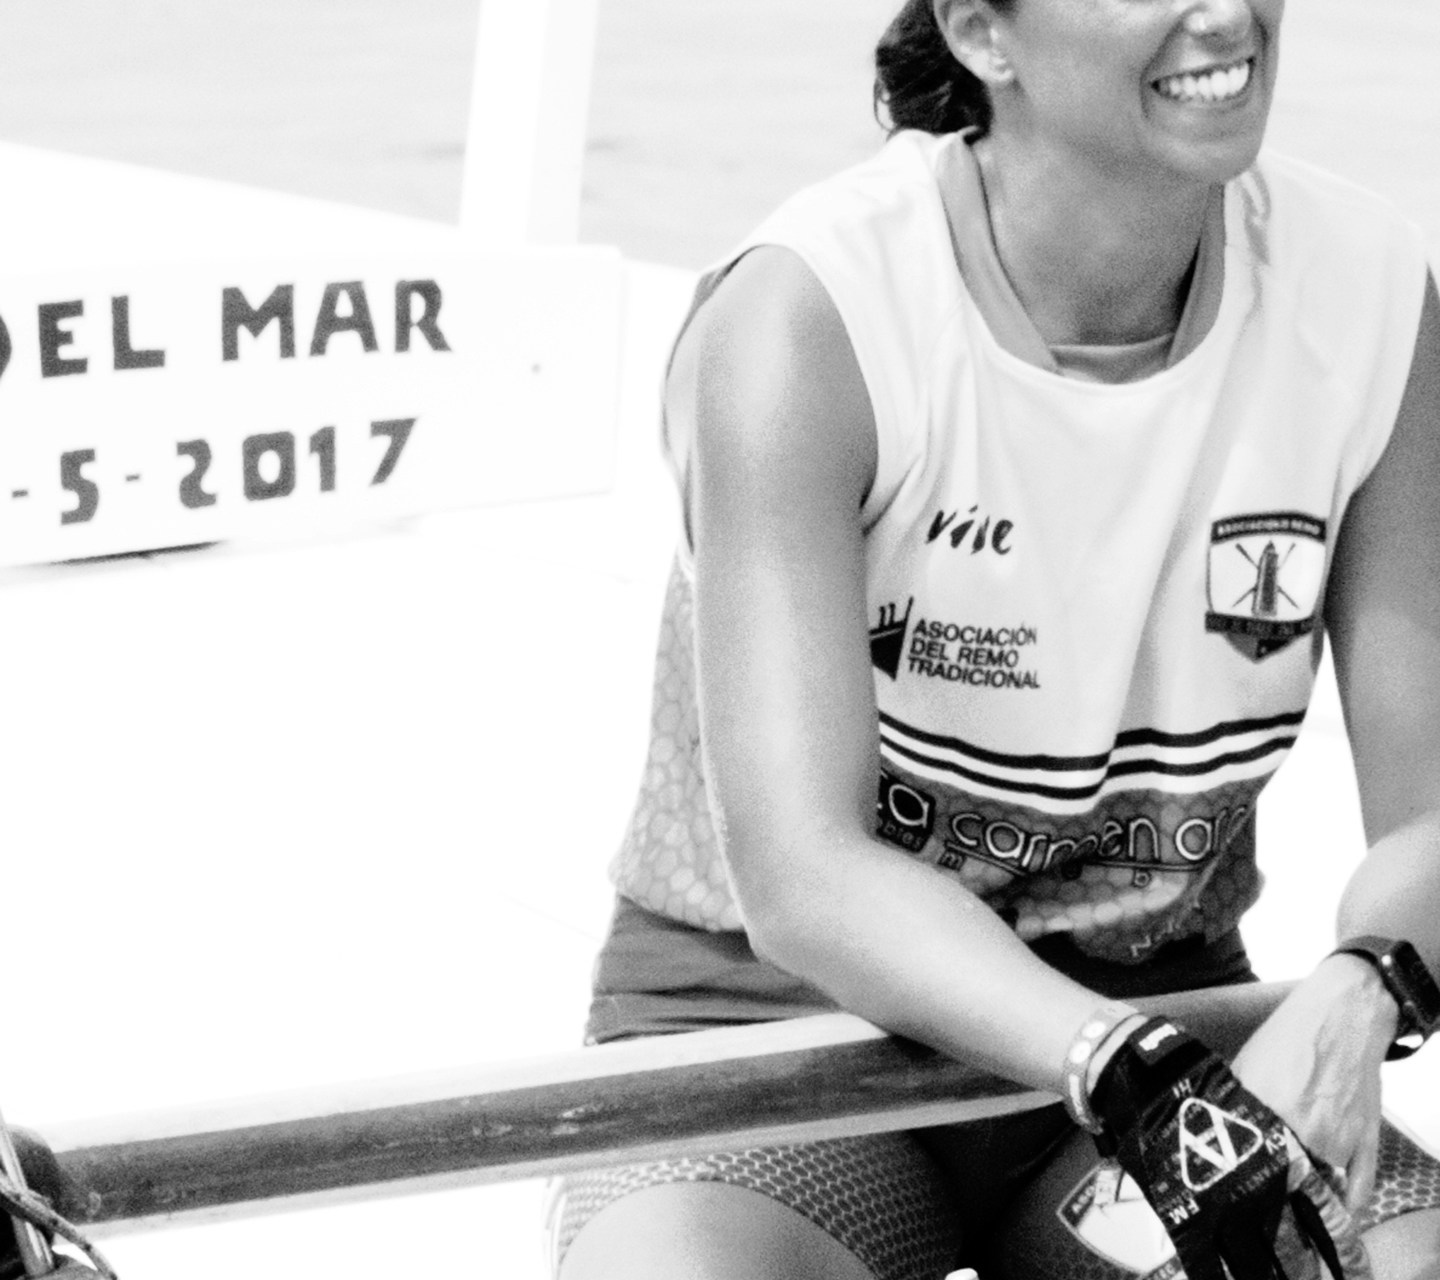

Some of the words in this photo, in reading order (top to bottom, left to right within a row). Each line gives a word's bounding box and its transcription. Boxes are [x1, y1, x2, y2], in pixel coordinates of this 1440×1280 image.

[0, 298, 166, 378] EL
[221, 279, 453, 362] MAR
[912, 618, 1037, 647] ASOCIACIÓN
[909, 637, 949, 661] DEL
[957, 646, 1019, 668] REMO
[907, 655, 1040, 688] TRADICIONAL
